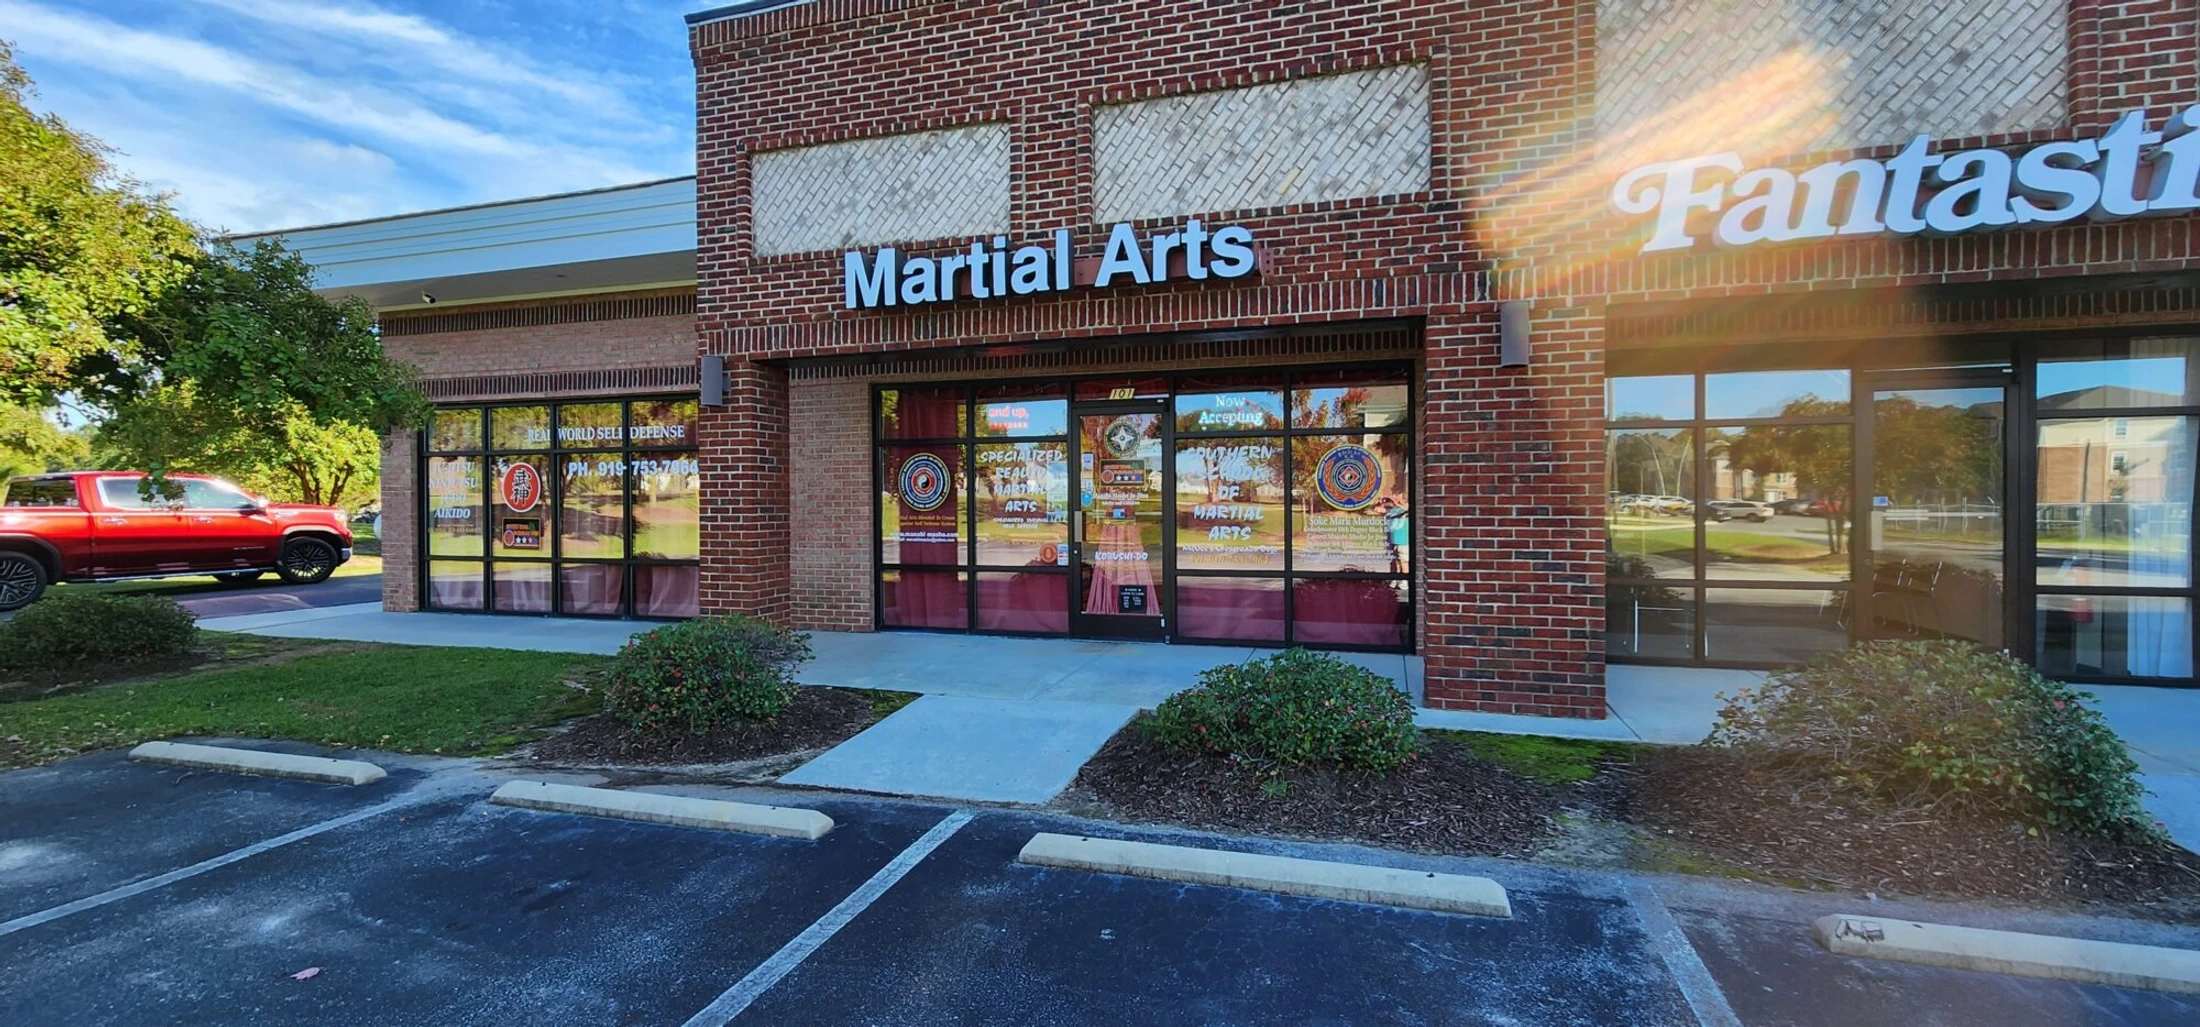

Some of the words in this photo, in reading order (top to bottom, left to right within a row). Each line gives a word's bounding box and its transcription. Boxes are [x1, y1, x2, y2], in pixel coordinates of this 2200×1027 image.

[844, 228, 1070, 309] Martial
[1094, 218, 1256, 287] Arts
[1109, 387, 1135, 400] 101
[1215, 395, 1246, 407] Now
[1198, 411, 1264, 426] Accepting
[557, 425, 595, 440] WORLD
[630, 424, 685, 439] DEFENSE
[980, 449, 1064, 463] SPECIALIZED
[1218, 486, 1240, 500] OF
[434, 507, 471, 519] AIKIDO
[1005, 500, 1038, 513] ARTS
[1193, 504, 1264, 520] MARTIAL
[1208, 525, 1252, 541] ARTS
